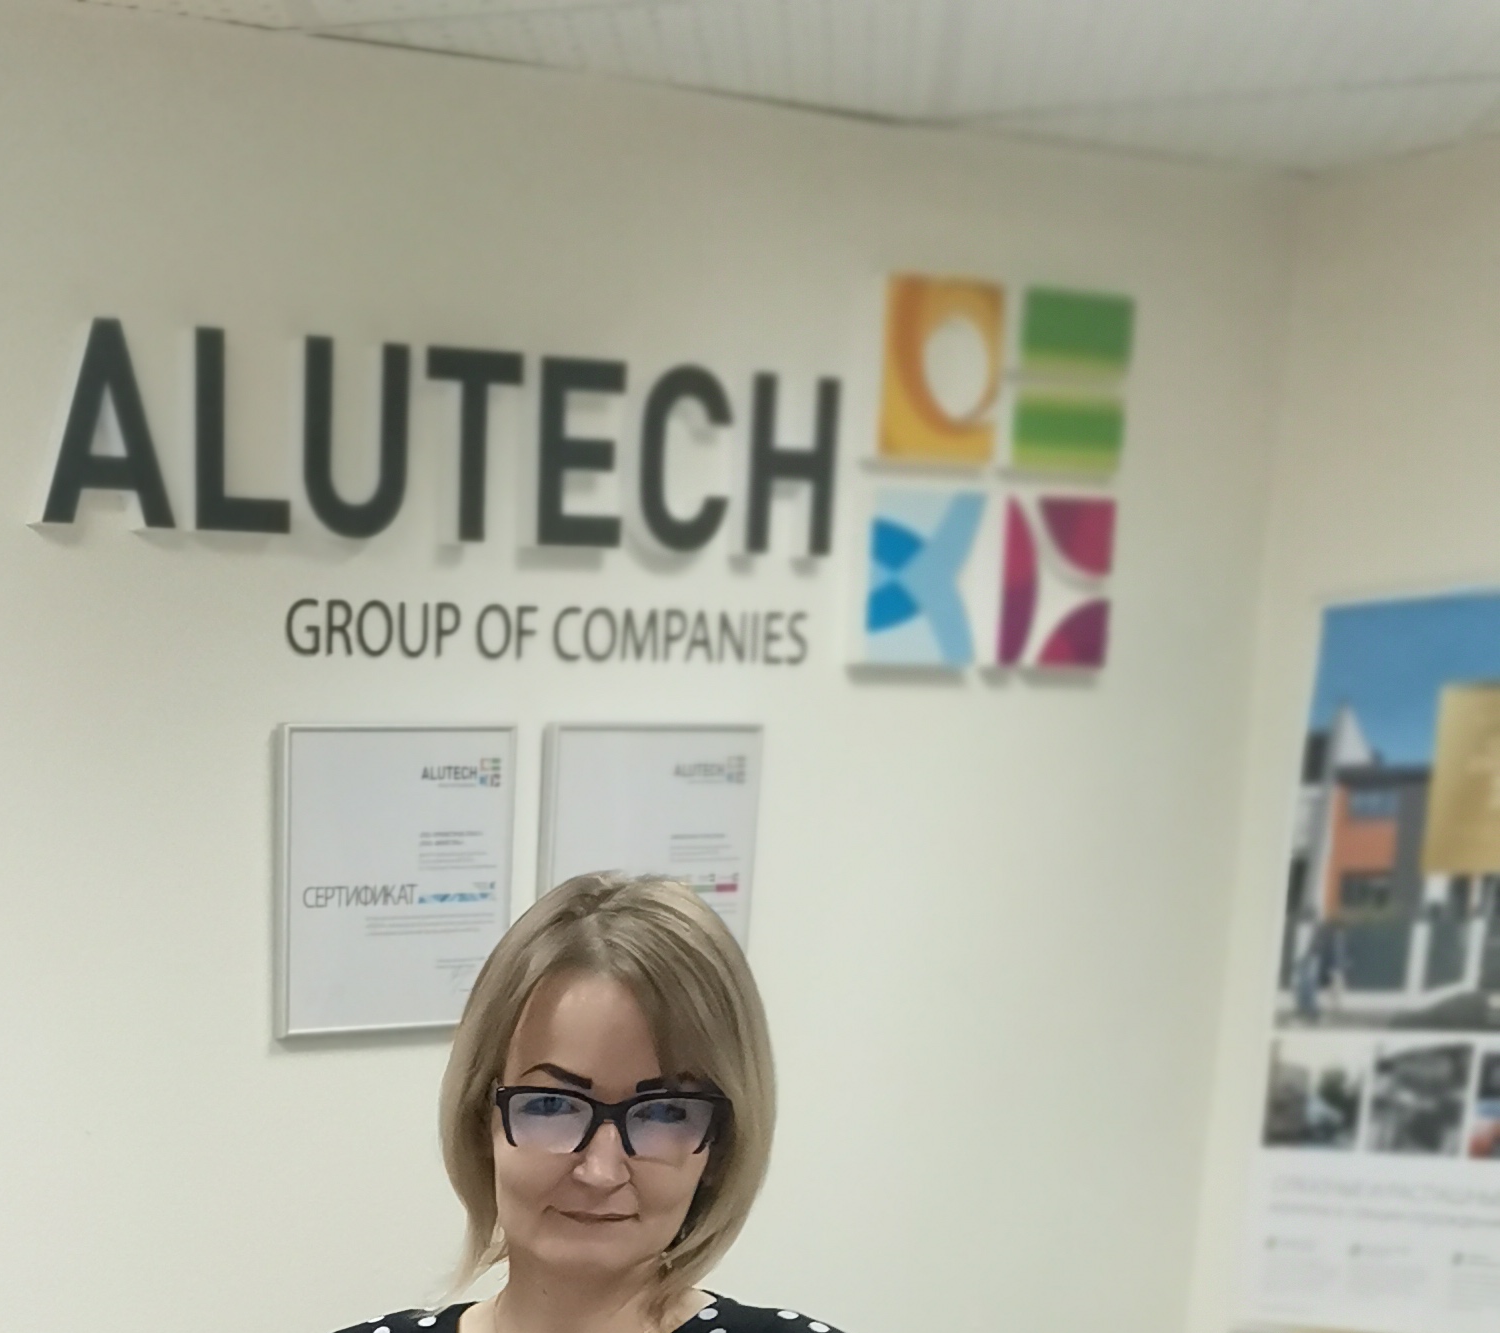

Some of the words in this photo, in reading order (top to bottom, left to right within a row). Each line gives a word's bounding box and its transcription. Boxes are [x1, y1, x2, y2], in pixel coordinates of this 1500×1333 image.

[41, 316, 842, 557] ALUTECH
[284, 597, 462, 659] GROUP
[475, 604, 540, 662] OF
[551, 606, 810, 666] COMPANIES
[421, 765, 479, 781] ALUTECH
[302, 883, 420, 909] СЕРТИФИКАТ
